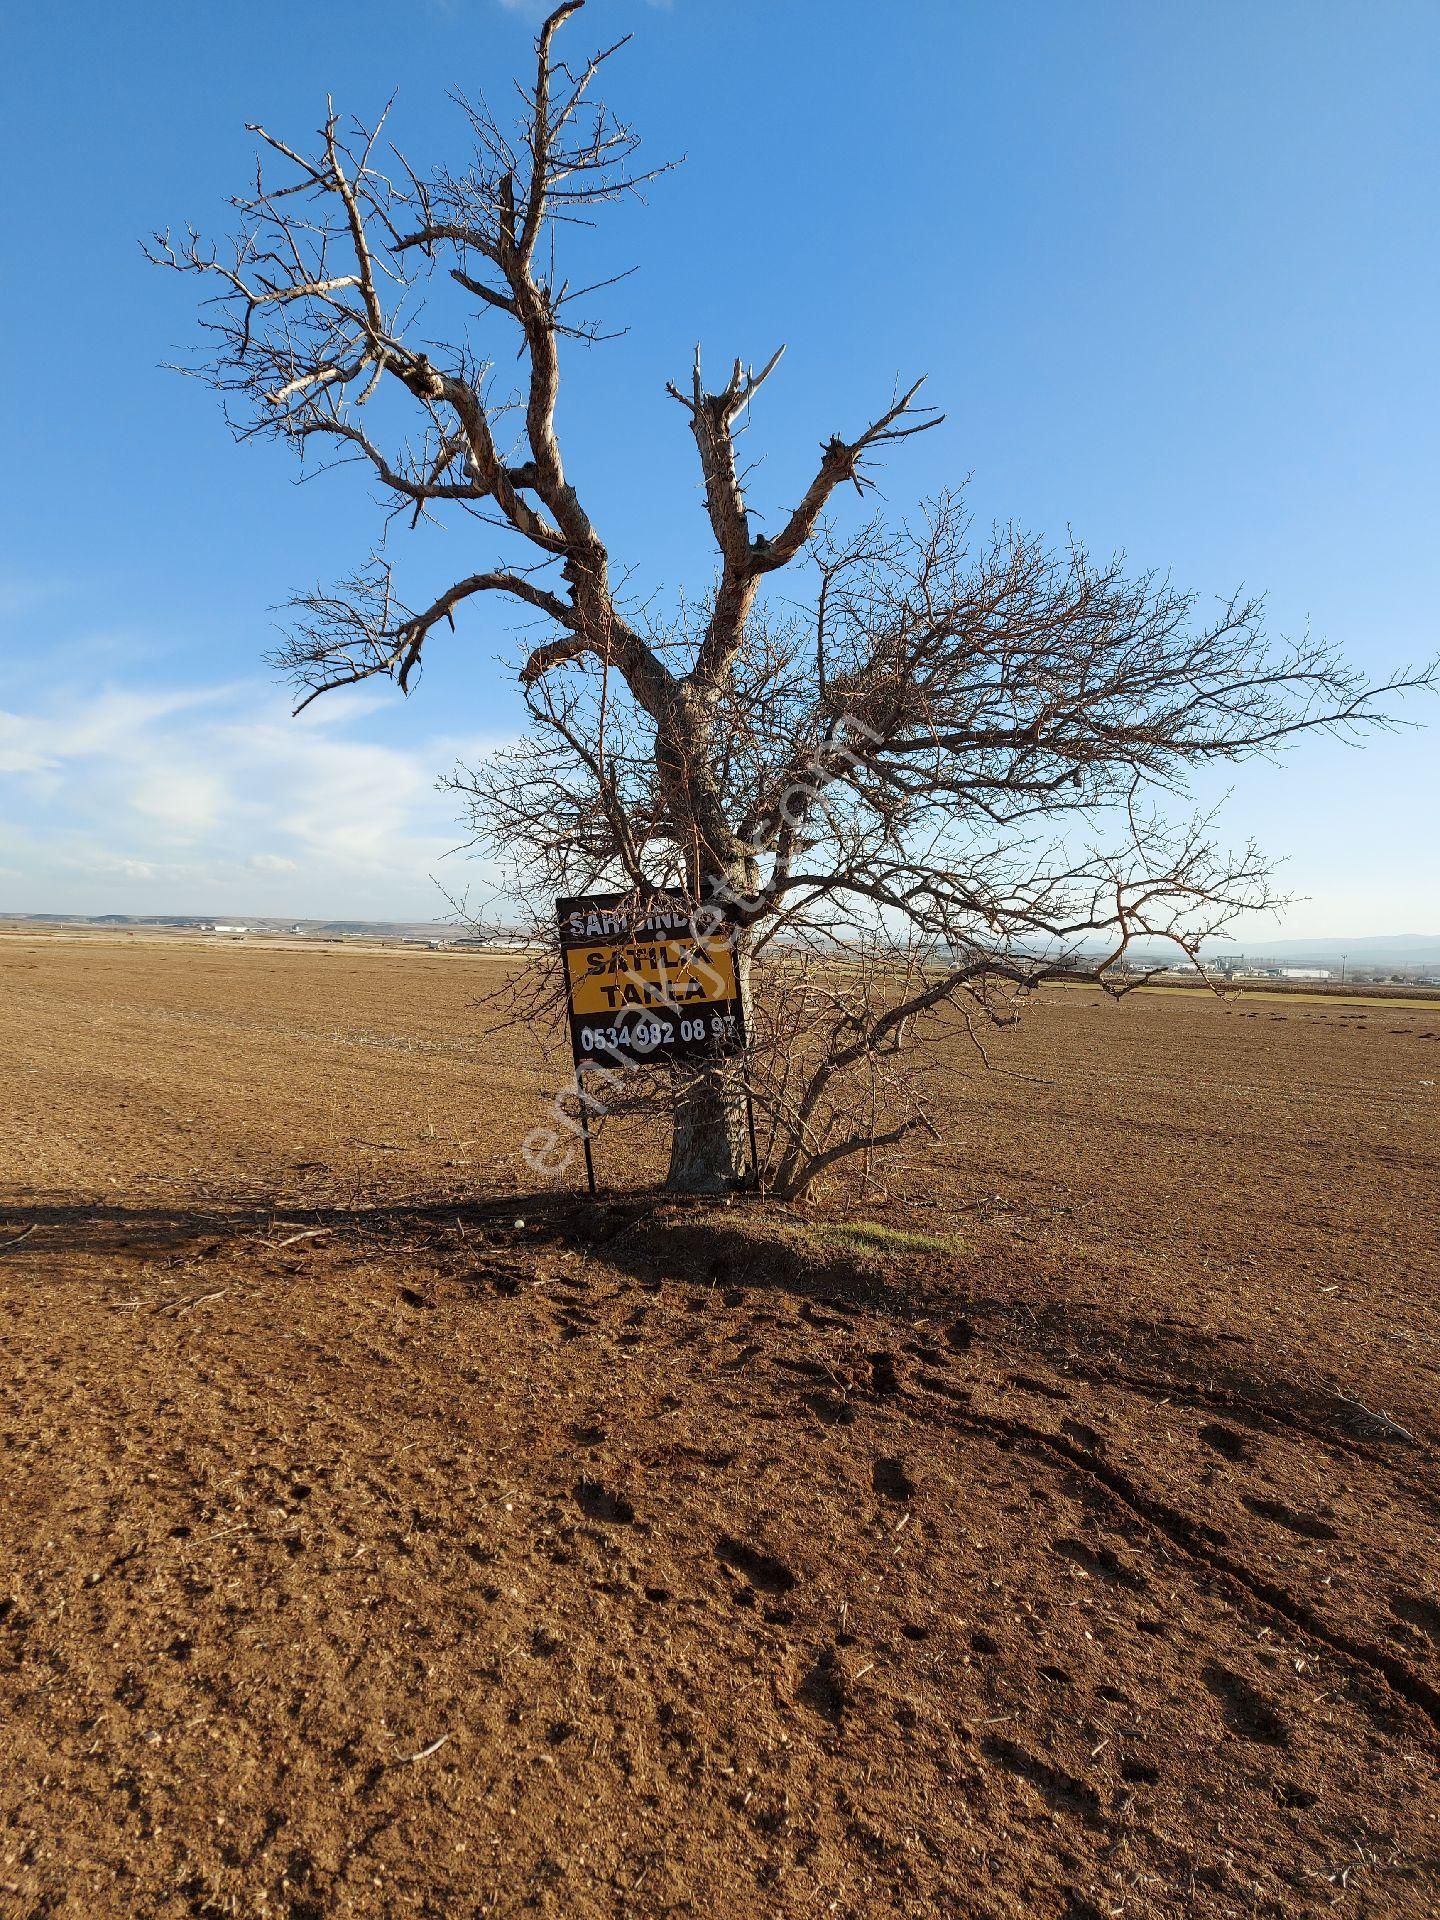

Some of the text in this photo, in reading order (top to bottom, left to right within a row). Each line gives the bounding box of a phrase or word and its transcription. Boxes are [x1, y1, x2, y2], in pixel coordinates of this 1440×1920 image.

[600, 976, 707, 1008] TARLA
[581, 1025, 631, 1051] 0534
[636, 1022, 675, 1046] 982
[680, 1018, 706, 1042] 08
